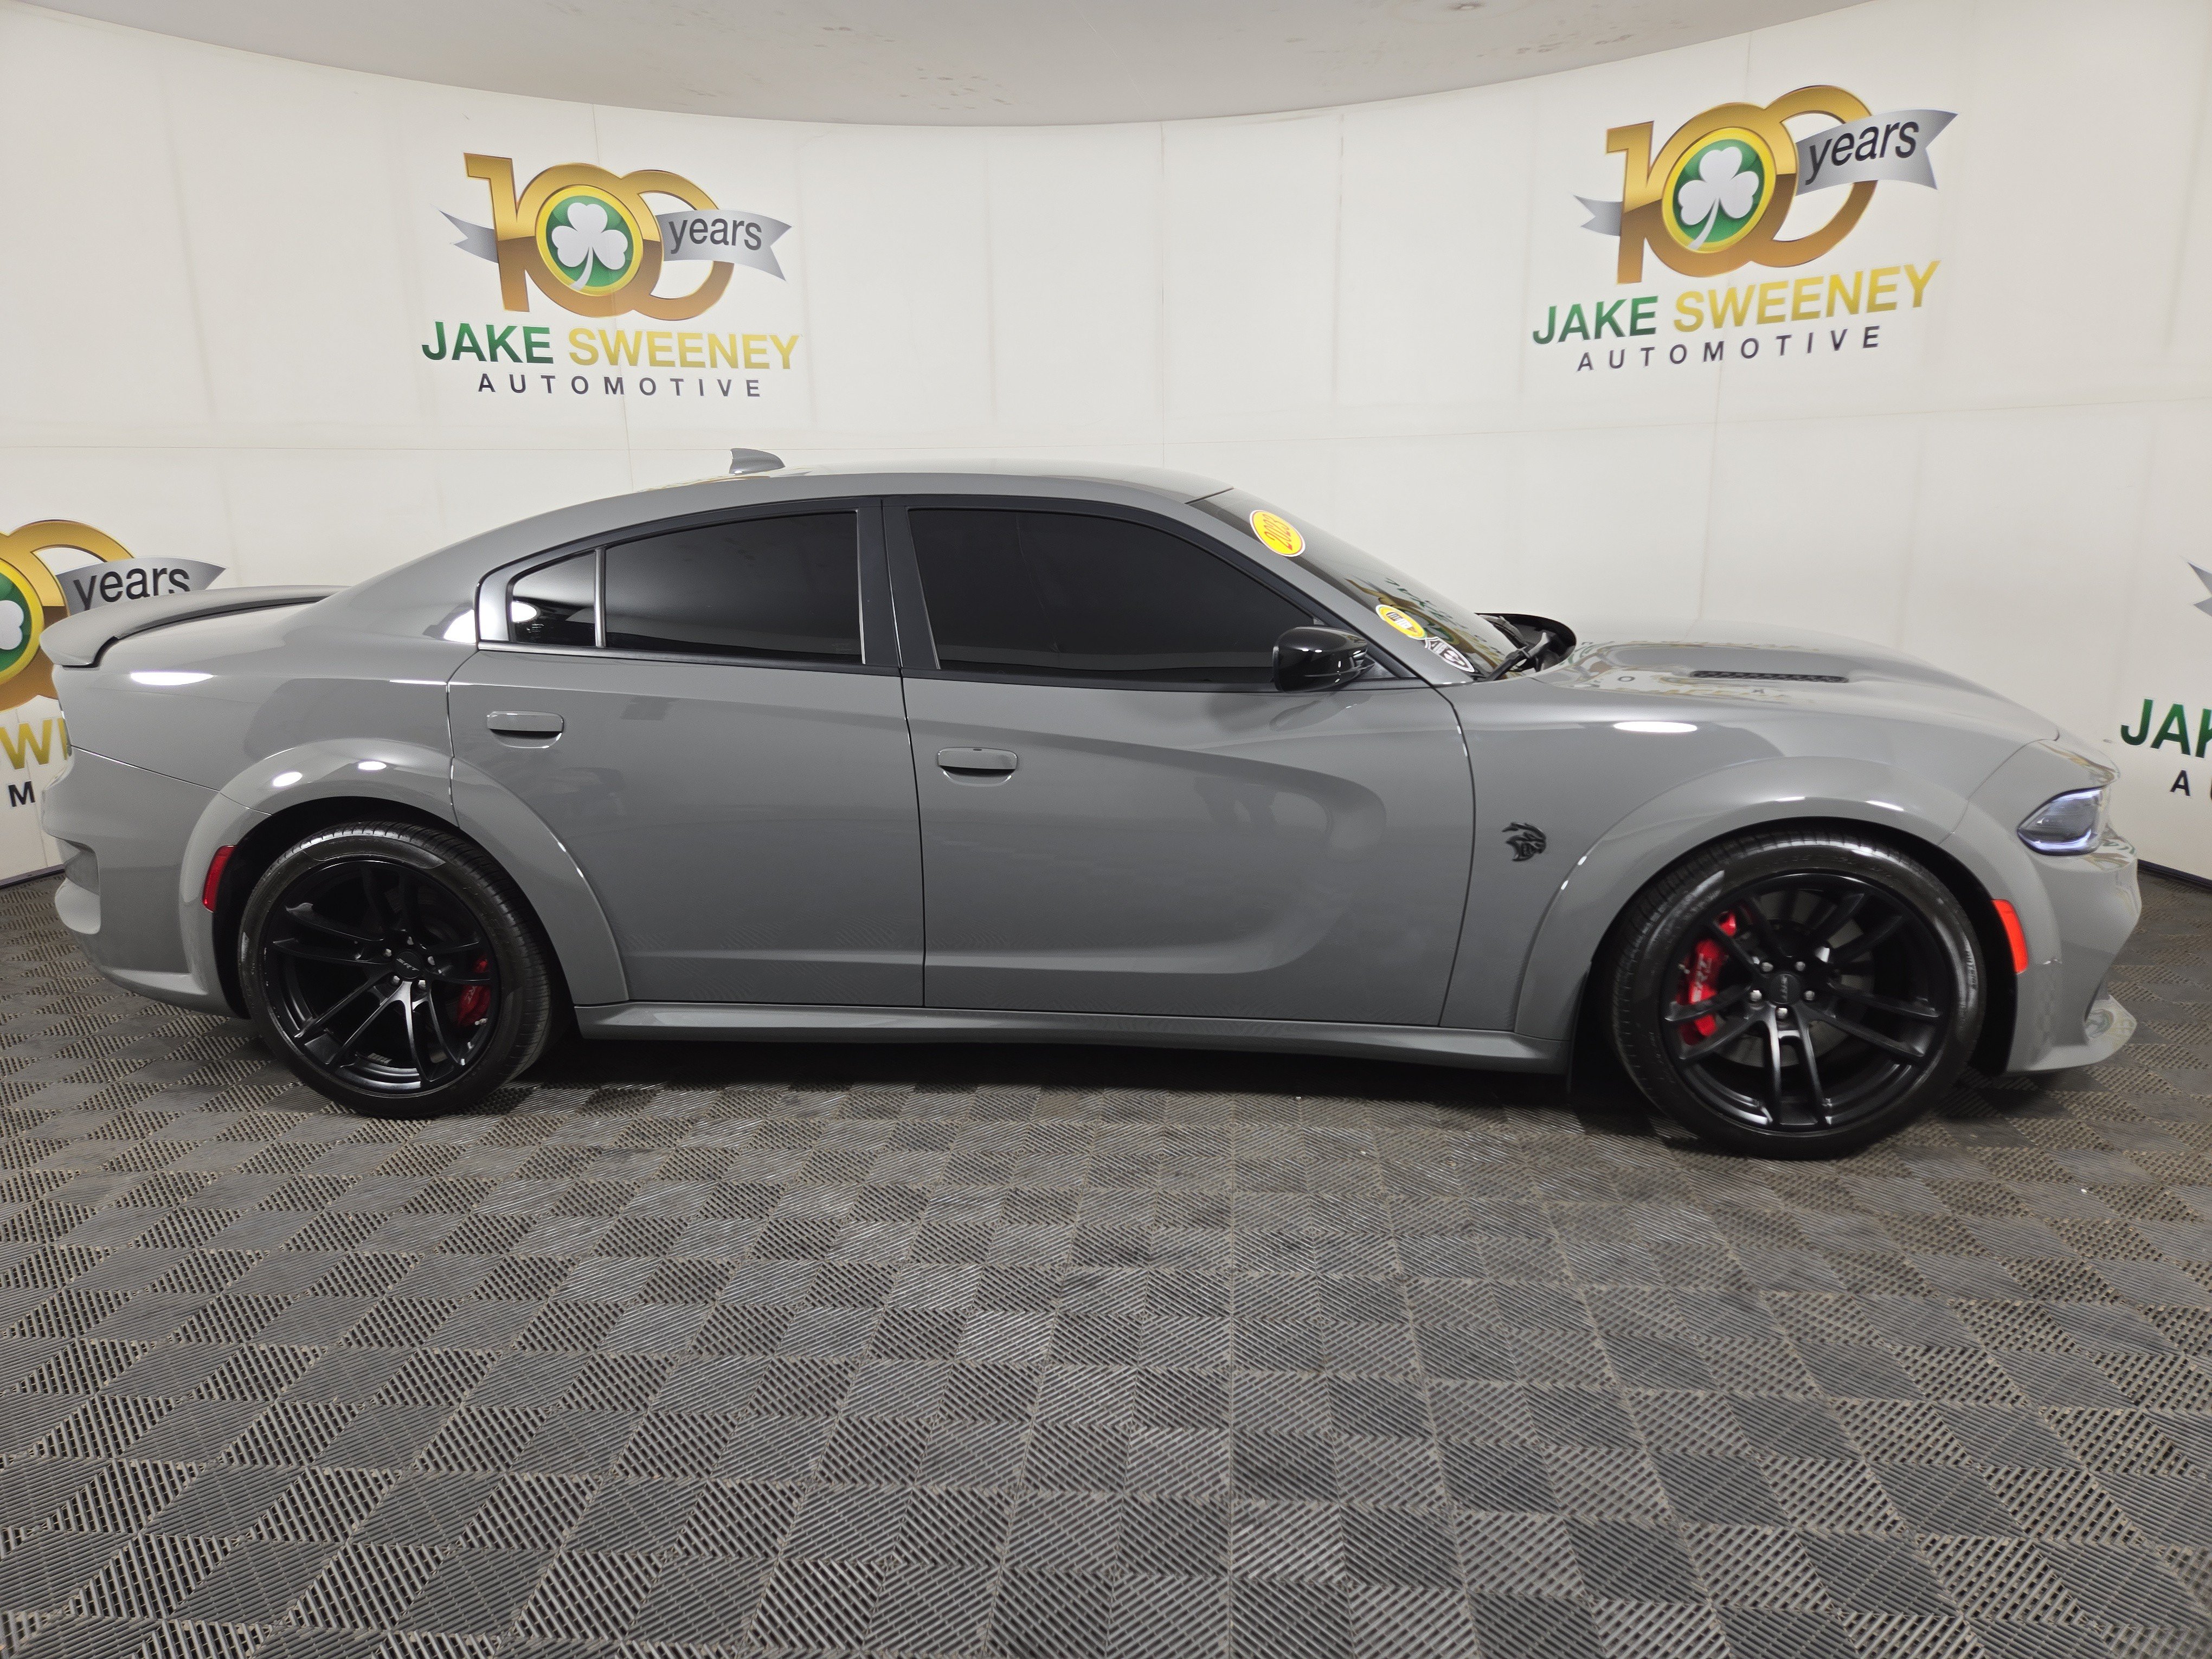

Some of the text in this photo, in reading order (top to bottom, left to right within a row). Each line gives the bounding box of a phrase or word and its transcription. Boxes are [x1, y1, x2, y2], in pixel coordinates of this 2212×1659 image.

[1805, 120, 1919, 185] years
[668, 217, 763, 254] years
[1532, 260, 1941, 345] JAKE SWEENEY
[421, 320, 800, 370] JAKE SWEENEY
[1577, 325, 1880, 371] AUTOMOTIVE
[478, 373, 761, 397] AUTOMOTIVE
[1262, 513, 1293, 551] 2023
[73, 567, 191, 610] years
